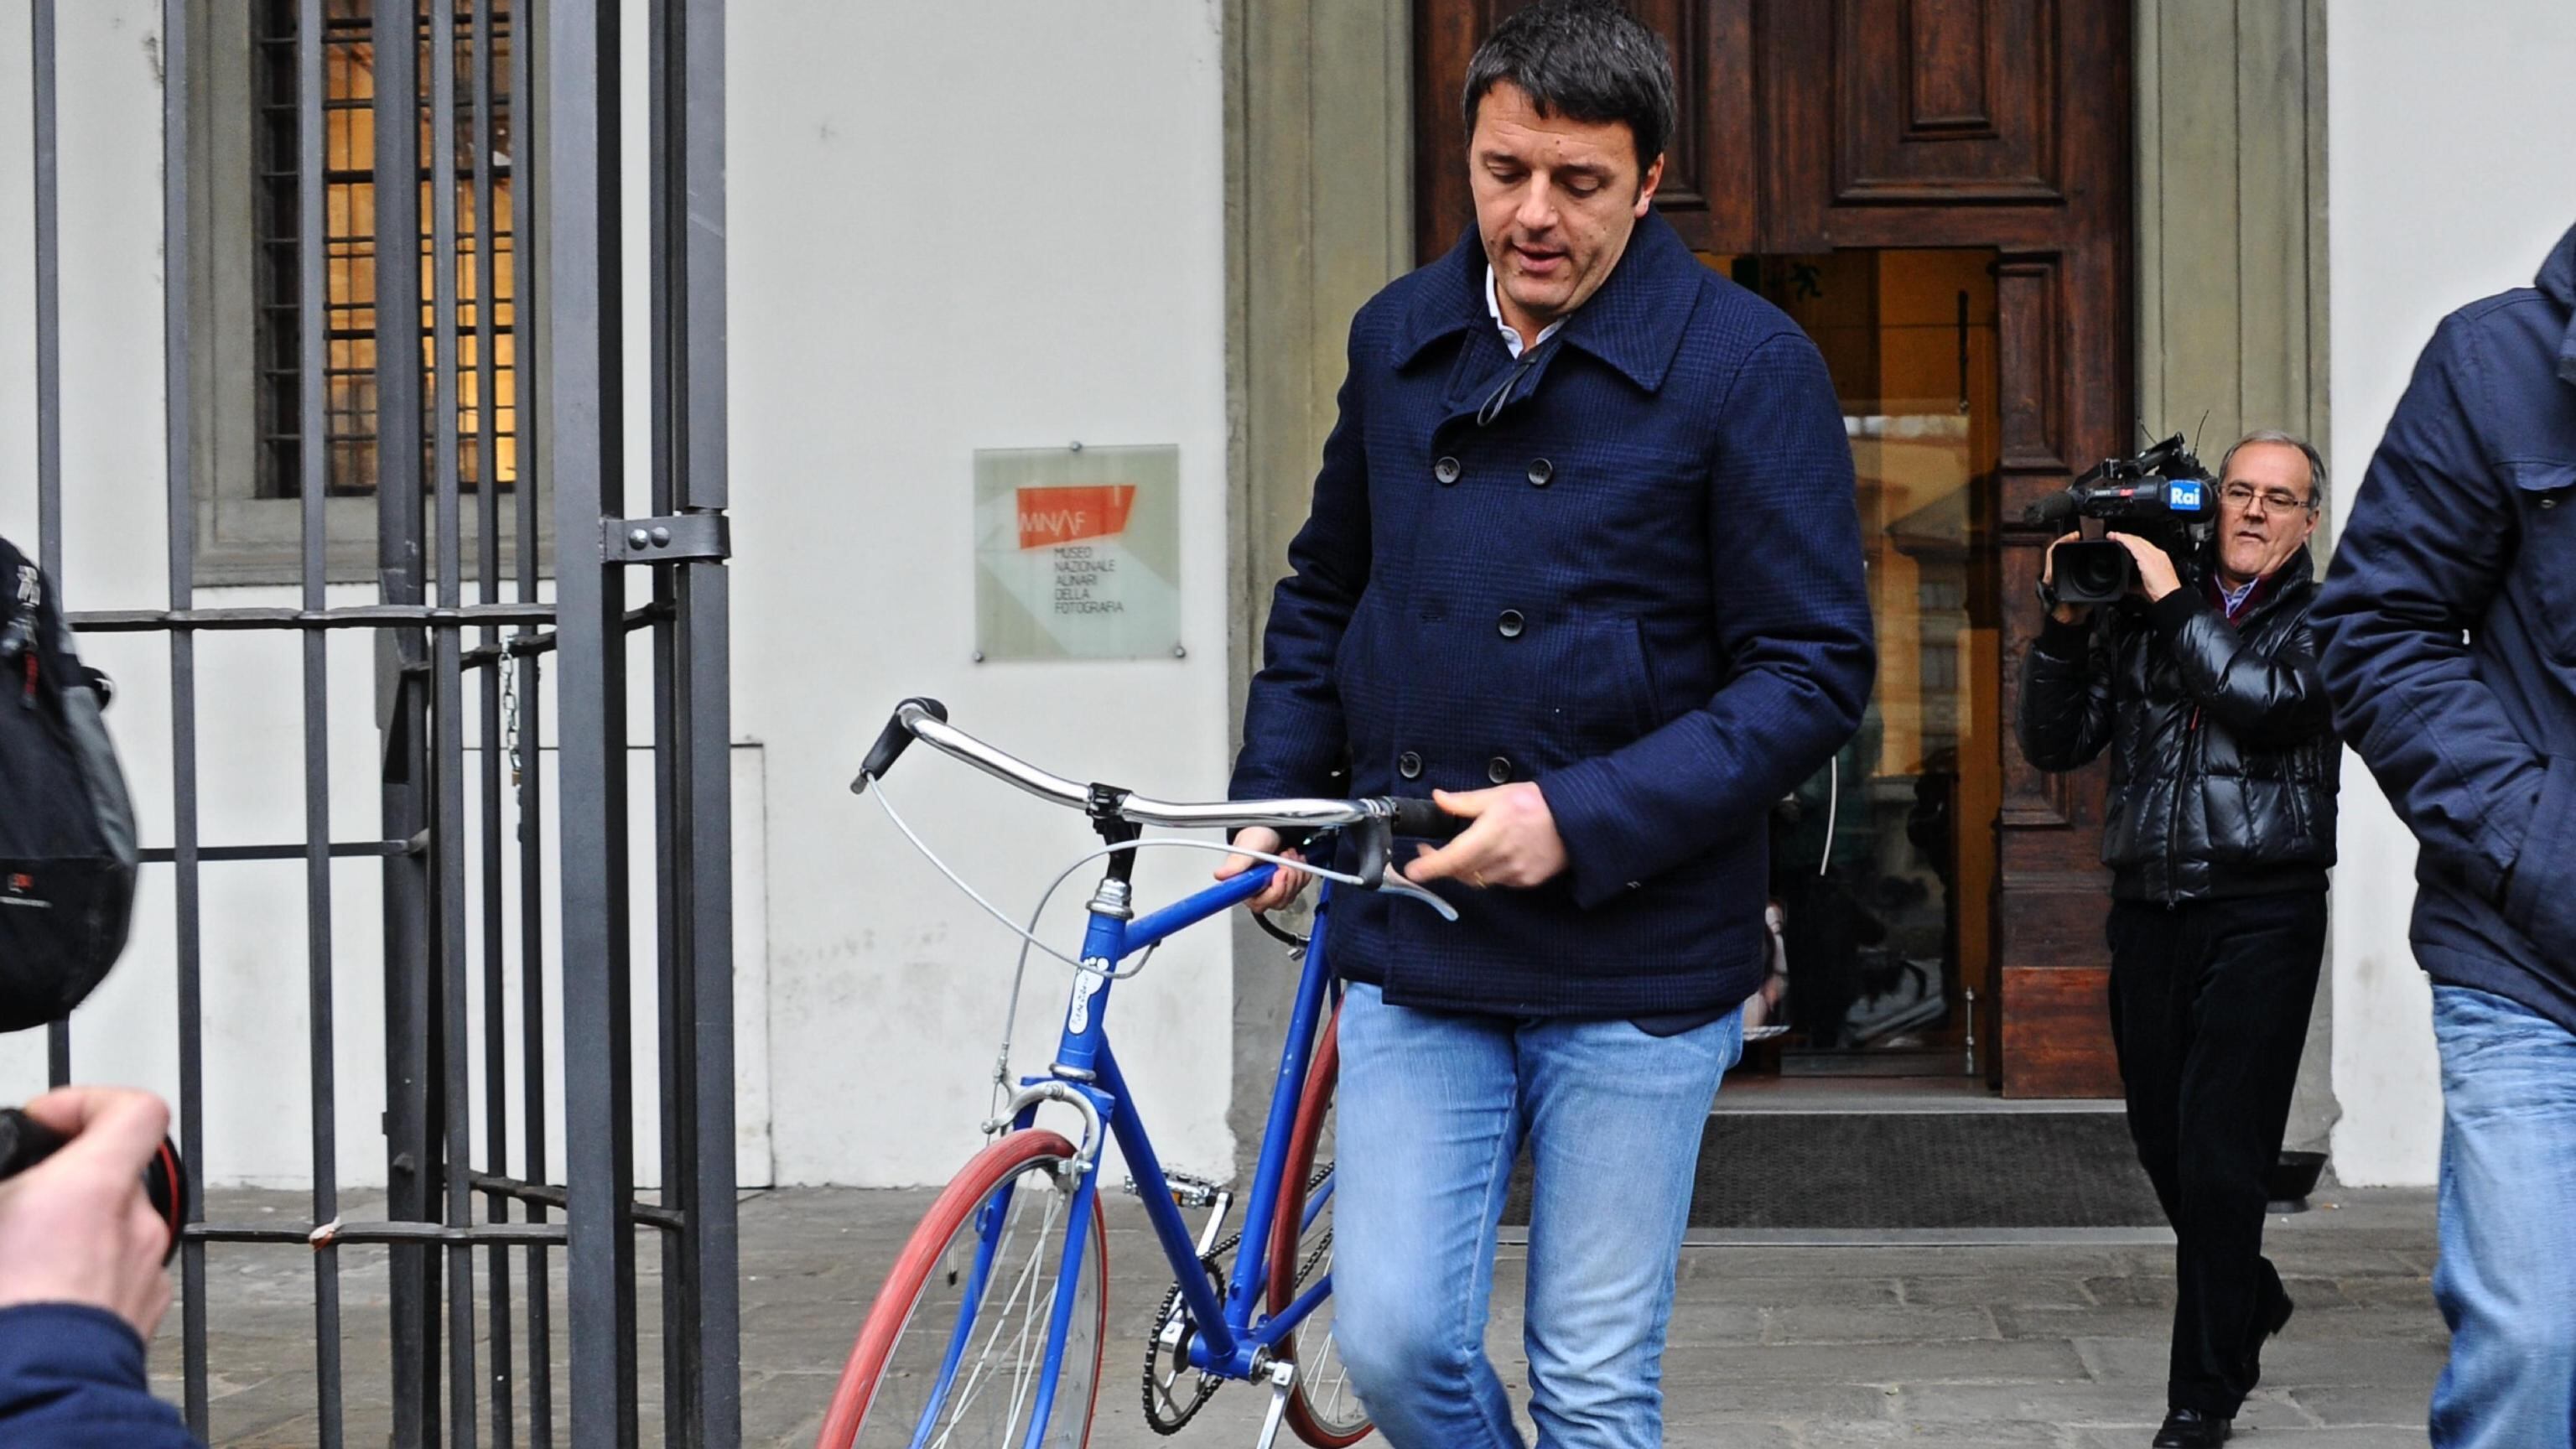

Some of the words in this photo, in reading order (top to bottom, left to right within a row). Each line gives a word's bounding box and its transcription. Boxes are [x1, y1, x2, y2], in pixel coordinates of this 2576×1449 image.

[2171, 487, 2200, 506] Rai
[1054, 546, 1092, 559] MUSEO
[1054, 558, 1115, 573] NAZIONALE
[1057, 574, 1098, 587] ALINARI
[1054, 588, 1090, 600] DELLA
[1054, 600, 1124, 614] FOTOGRAFIA
